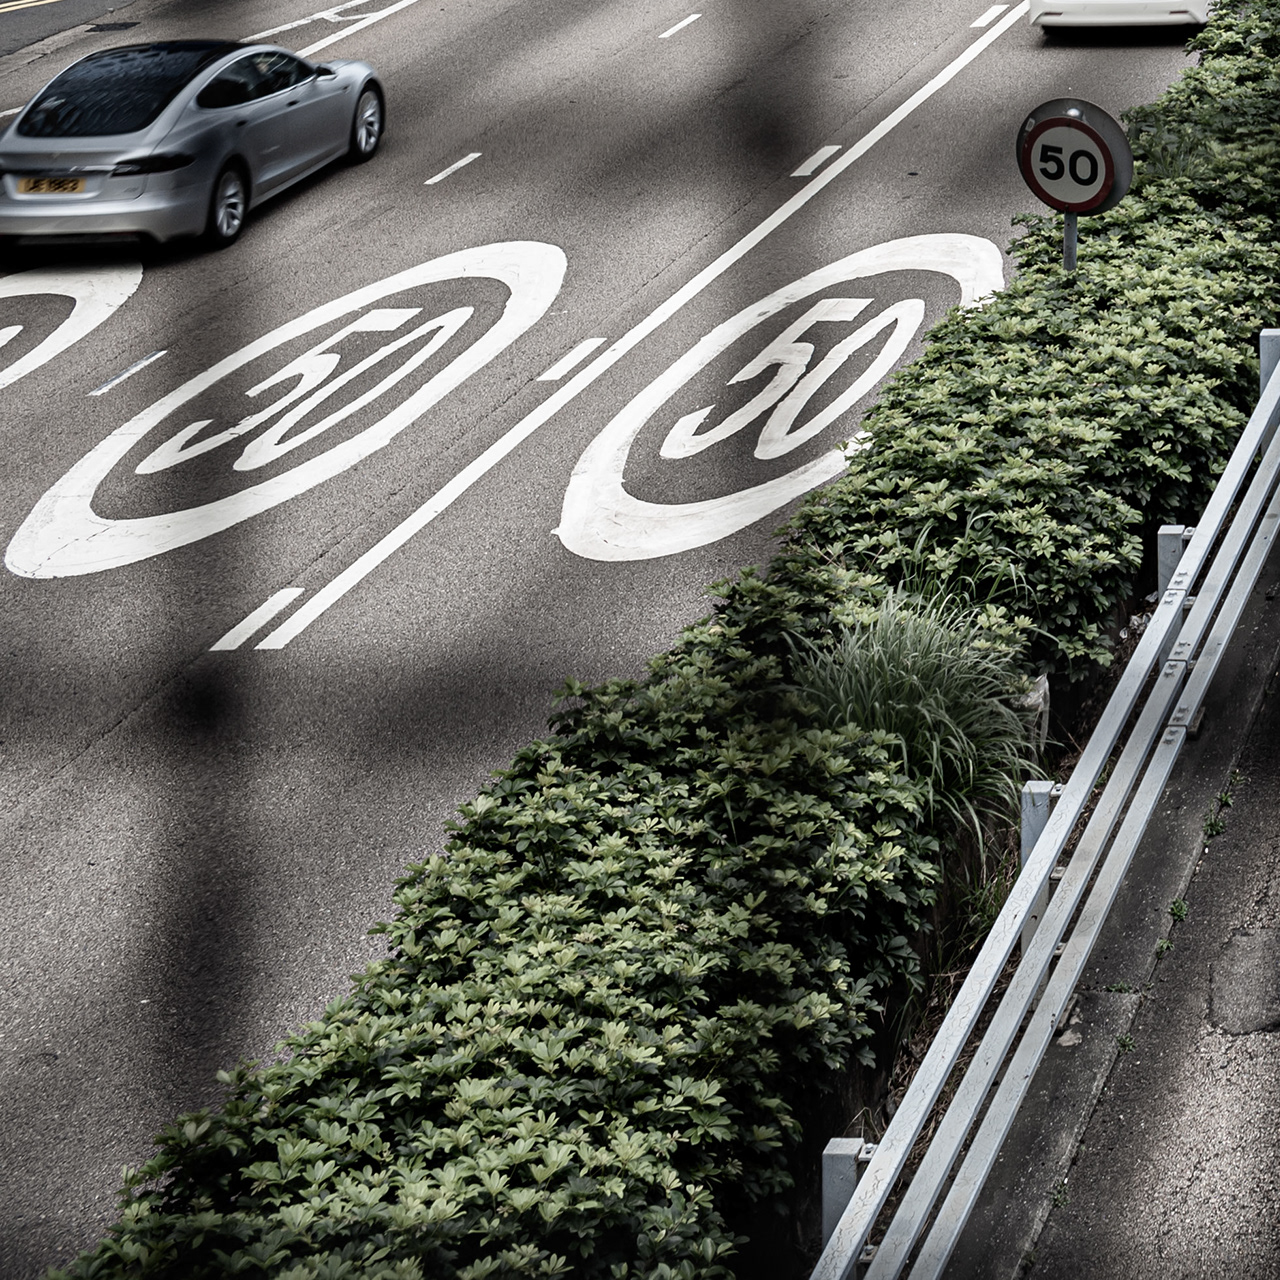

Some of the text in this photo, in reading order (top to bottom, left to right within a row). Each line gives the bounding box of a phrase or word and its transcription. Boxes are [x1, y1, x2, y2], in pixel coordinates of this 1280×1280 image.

[1039, 143, 1098, 186] 50
[134, 306, 475, 475] 50
[660, 296, 925, 461] 50
